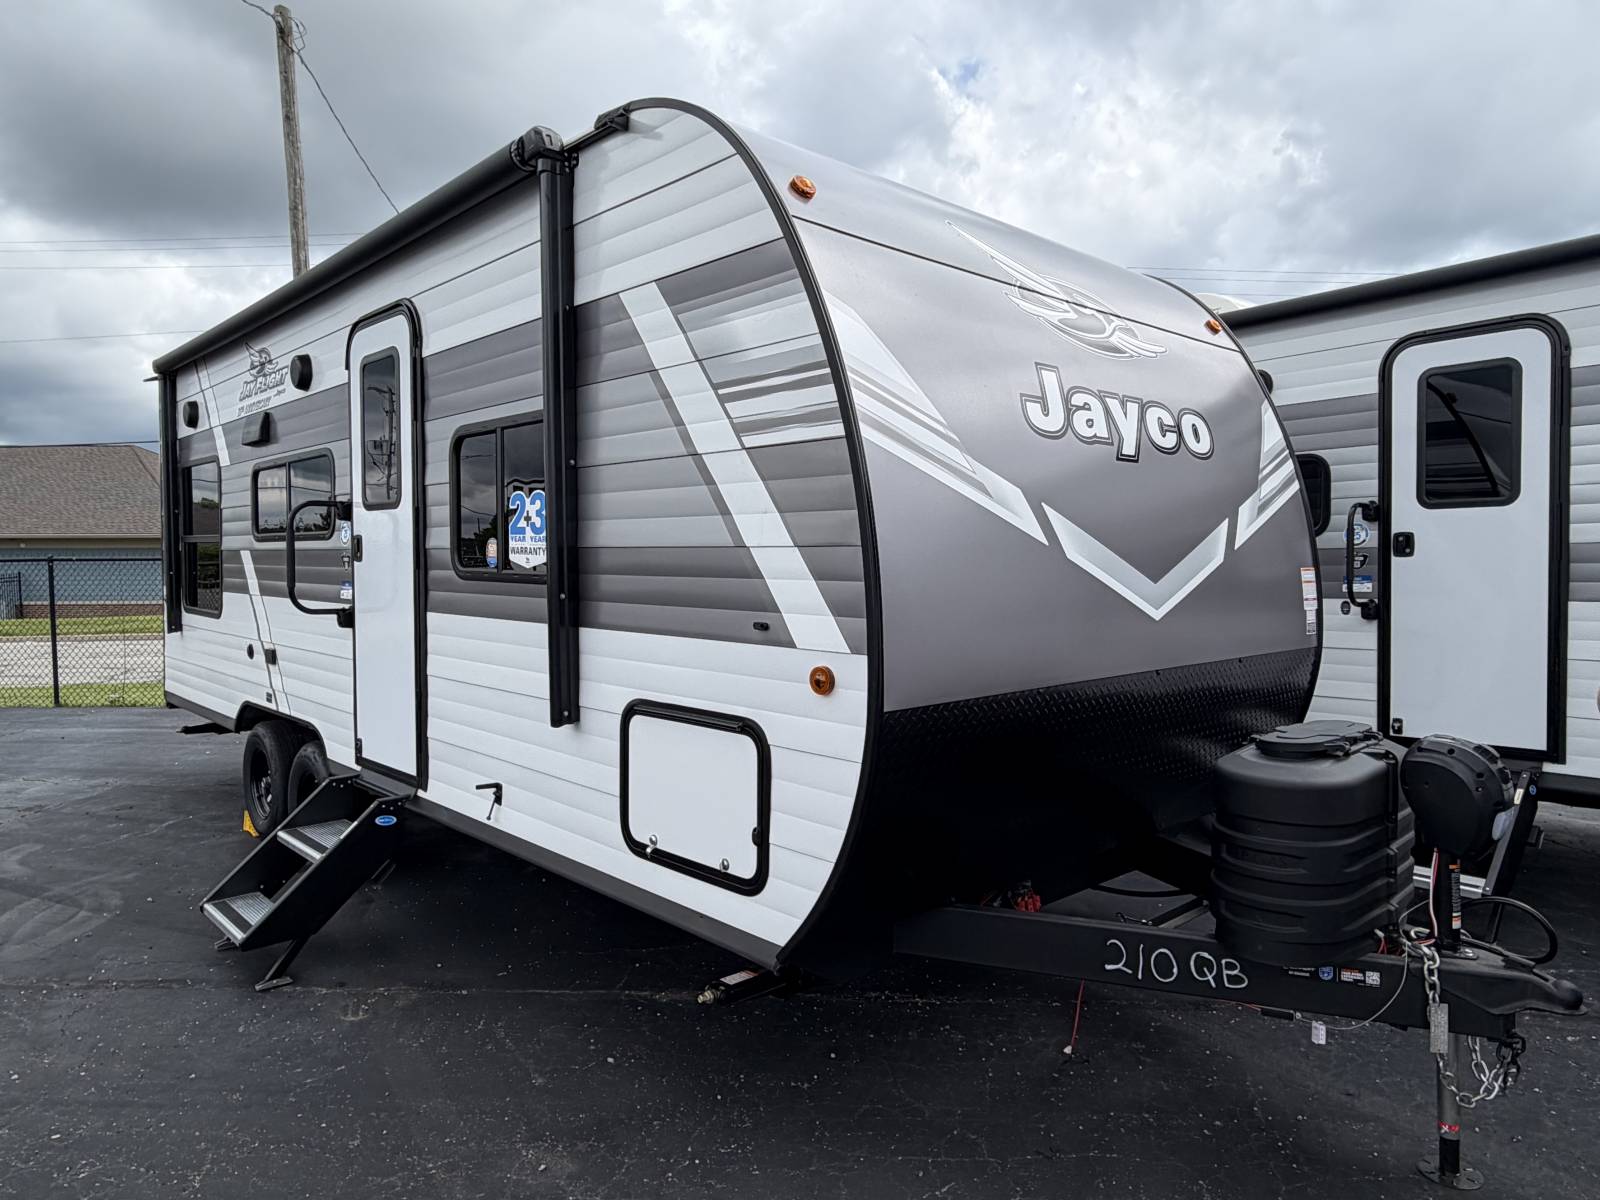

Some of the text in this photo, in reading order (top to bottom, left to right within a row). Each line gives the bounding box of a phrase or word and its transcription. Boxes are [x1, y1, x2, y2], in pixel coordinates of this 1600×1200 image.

[1020, 362, 1214, 463] Jayco
[510, 535, 526, 543] YEAR
[510, 546, 546, 556] WARRANTY
[1105, 939, 1248, 989] 210 QB
